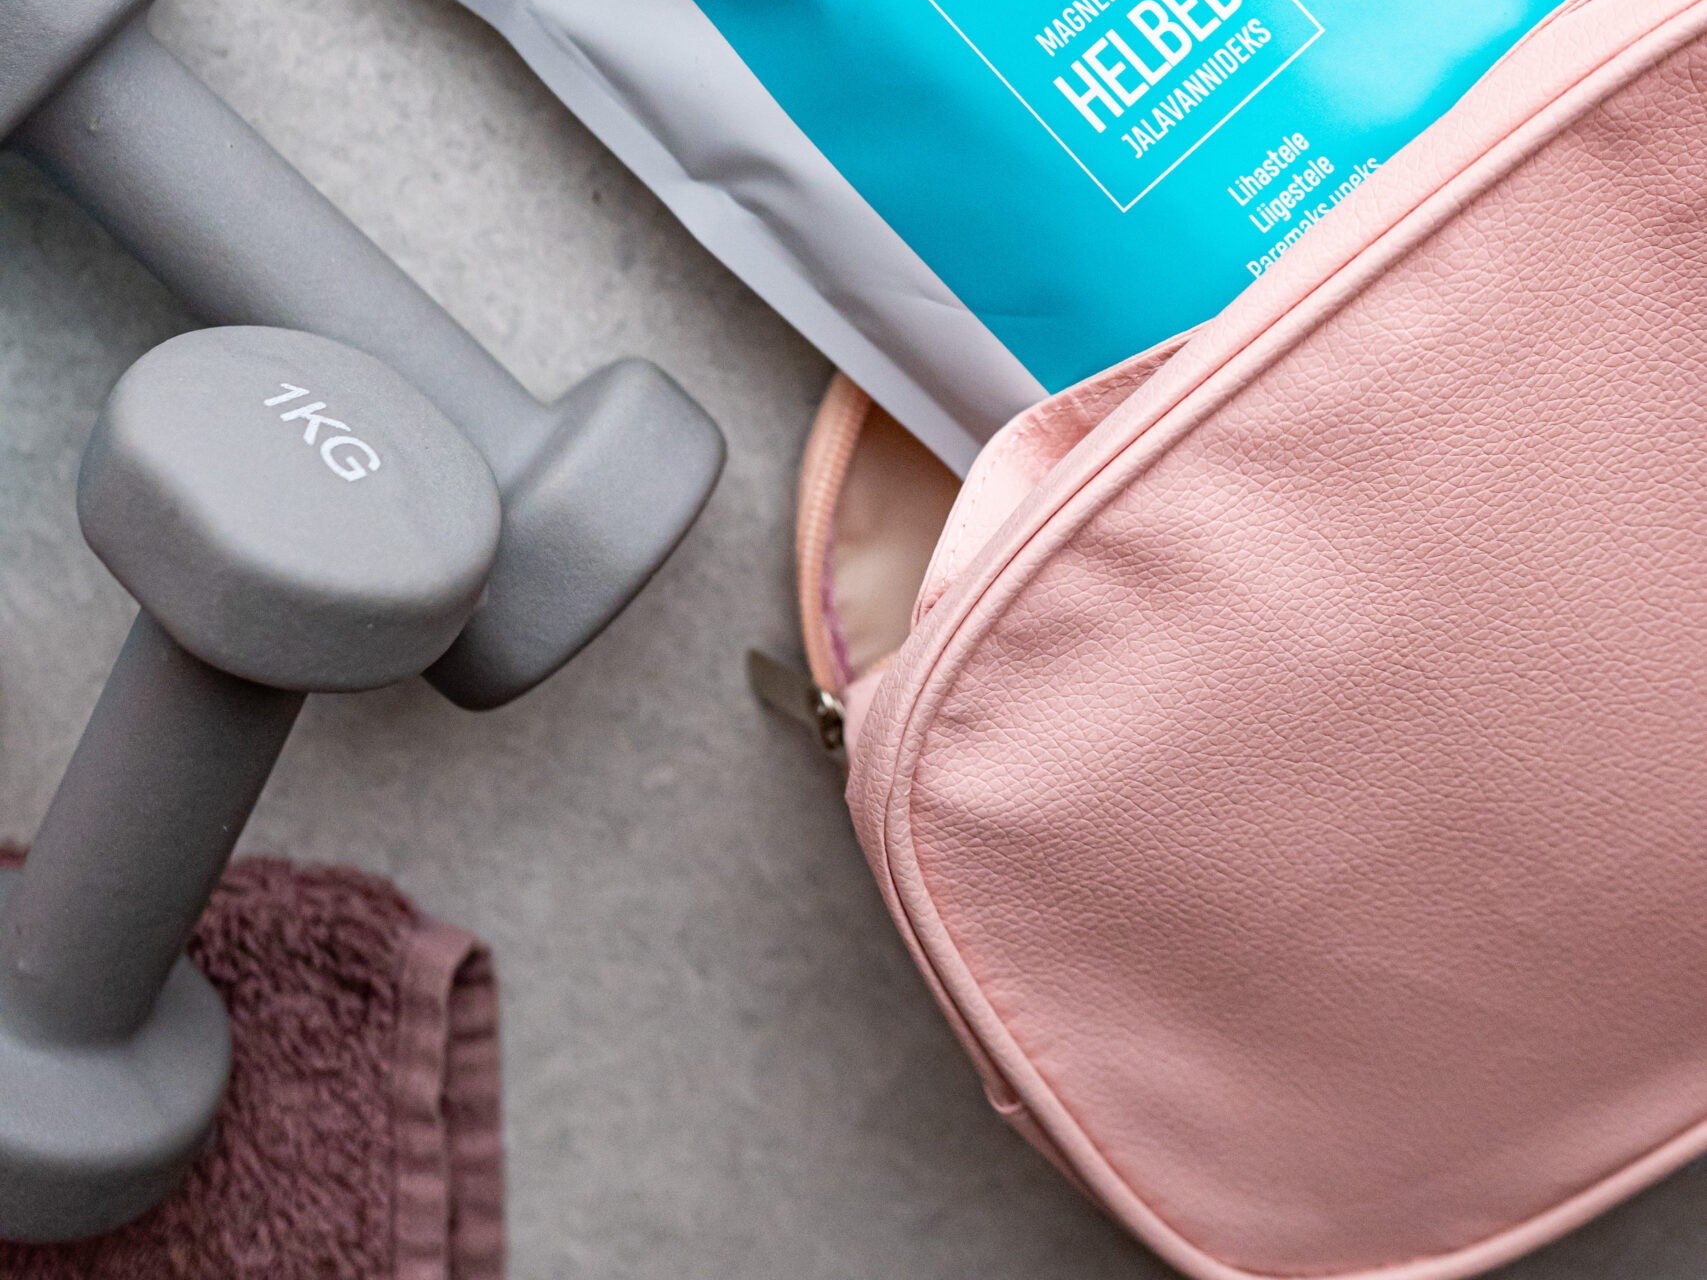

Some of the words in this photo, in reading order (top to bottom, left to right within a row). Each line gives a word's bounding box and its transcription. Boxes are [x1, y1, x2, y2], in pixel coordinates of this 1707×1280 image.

[1121, 19, 1271, 159] JALAVANNIDEKS
[1228, 132, 1310, 206] Lihastele
[1249, 156, 1334, 233] Liigestele
[263, 382, 381, 482] 1KG
